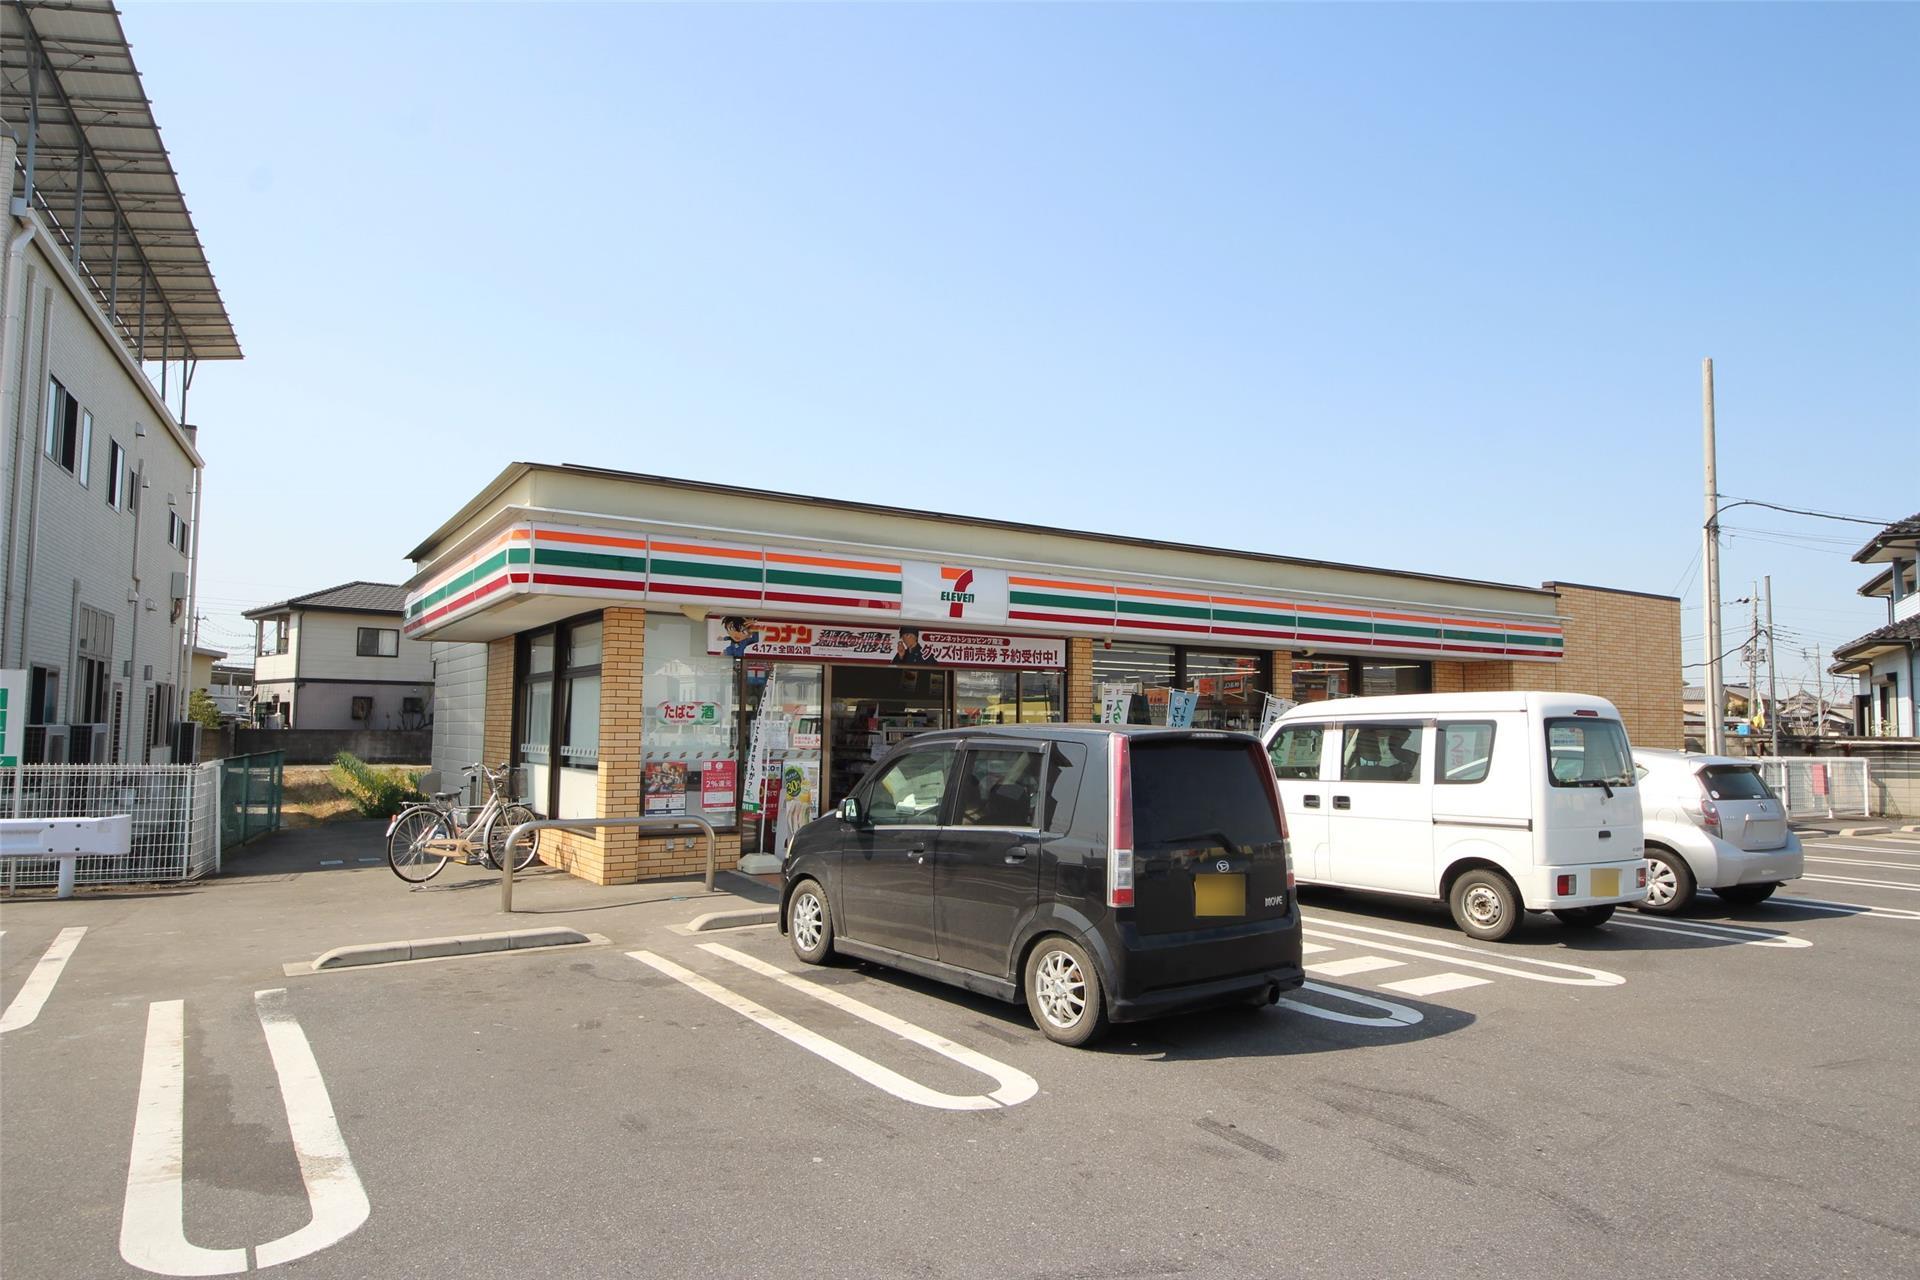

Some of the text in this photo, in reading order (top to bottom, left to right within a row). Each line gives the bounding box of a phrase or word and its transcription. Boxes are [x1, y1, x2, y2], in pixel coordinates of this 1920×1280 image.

[941, 591, 975, 603] ELEVEN
[765, 624, 812, 644] コナン
[664, 704, 714, 718] たばこ 酒
[1265, 896, 1283, 907] MOVE
